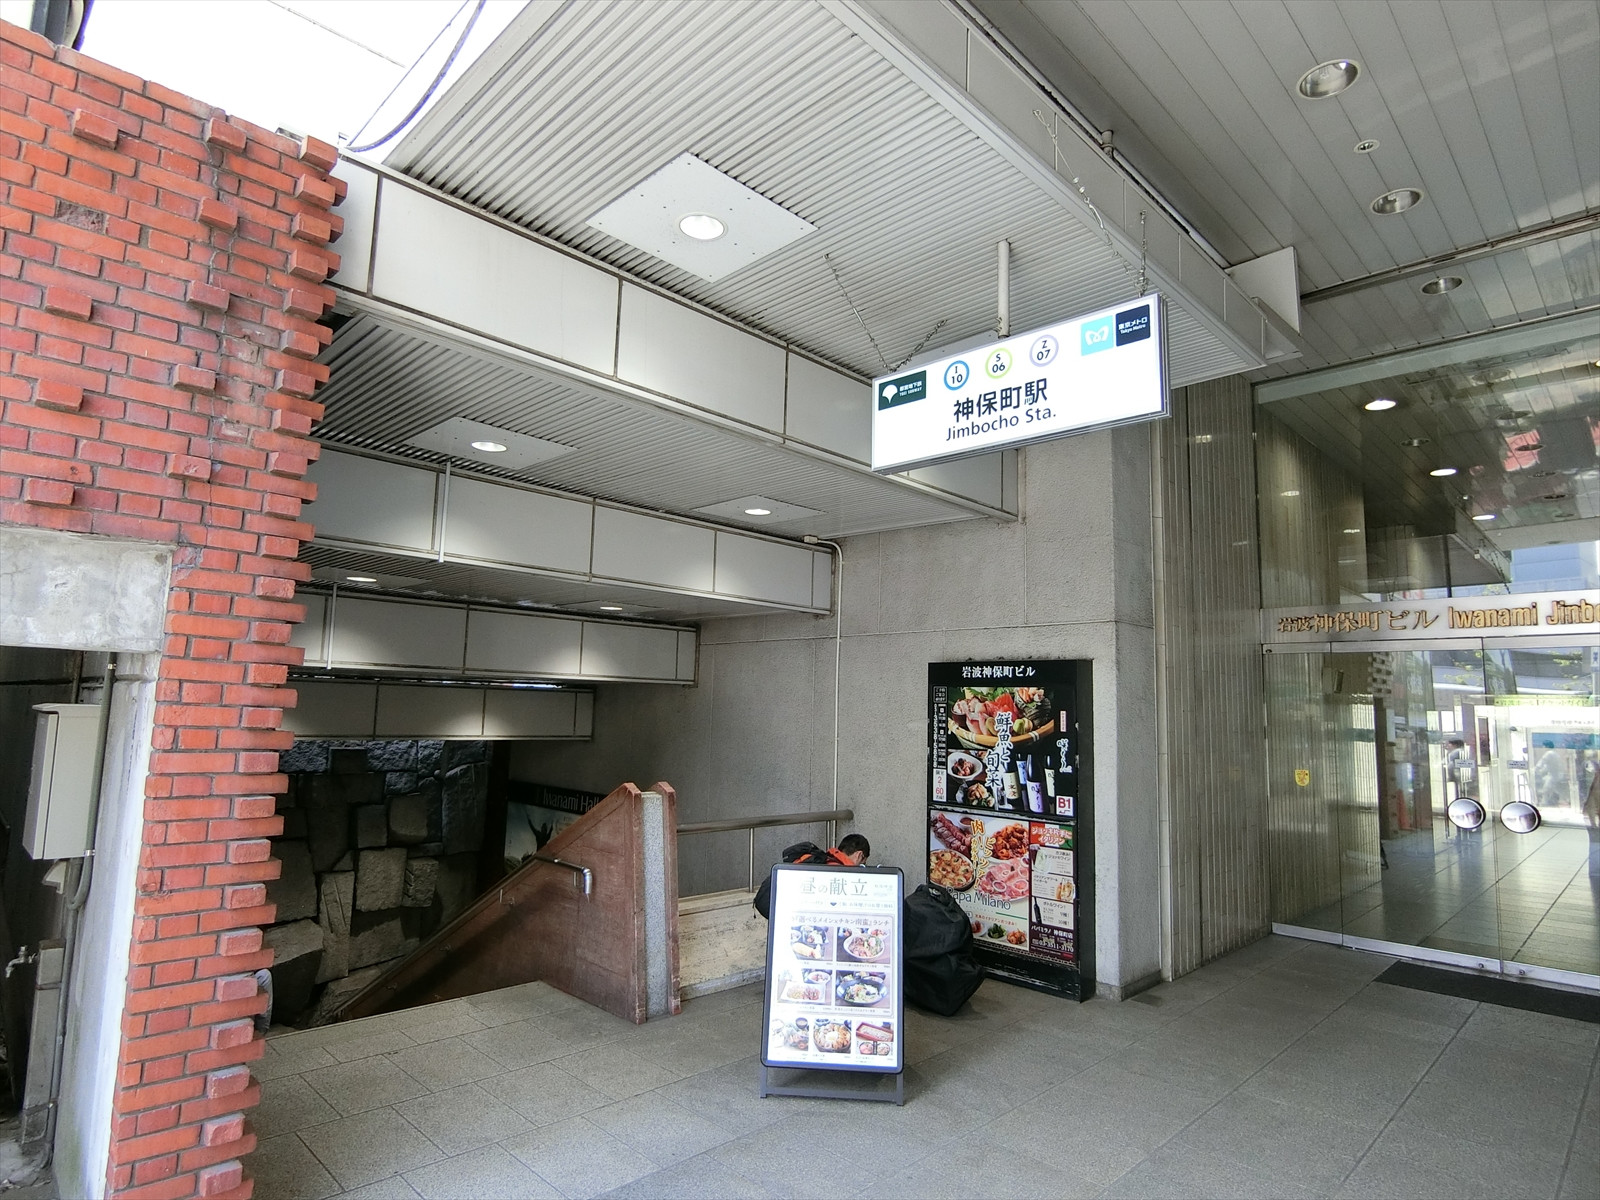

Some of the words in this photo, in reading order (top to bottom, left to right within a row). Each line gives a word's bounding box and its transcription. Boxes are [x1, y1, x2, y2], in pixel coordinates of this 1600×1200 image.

[1042, 340, 1048, 349] Z
[995, 352, 1001, 362] S
[1036, 349, 1051, 361] 07
[953, 365, 959, 375] I
[992, 362, 1006, 373] 06
[951, 374, 963, 385] 10
[953, 378, 1048, 423] 神保町駅
[946, 414, 1020, 442] Jimbocho
[1025, 405, 1057, 425] Sta.
[1277, 608, 1440, 633] 岩波神保町ビル
[1448, 602, 1538, 629] Iwanami
[961, 665, 1036, 679] 岩波神保町ビル
[995, 712, 1013, 761] 鮮魚と
[985, 750, 1001, 787] 旬菜
[937, 776, 942, 784] 2
[935, 787, 944, 795] 60
[1058, 797, 1071, 809] B1
[801, 877, 868, 896] 昼の献立
[973, 891, 1011, 910] Milano
